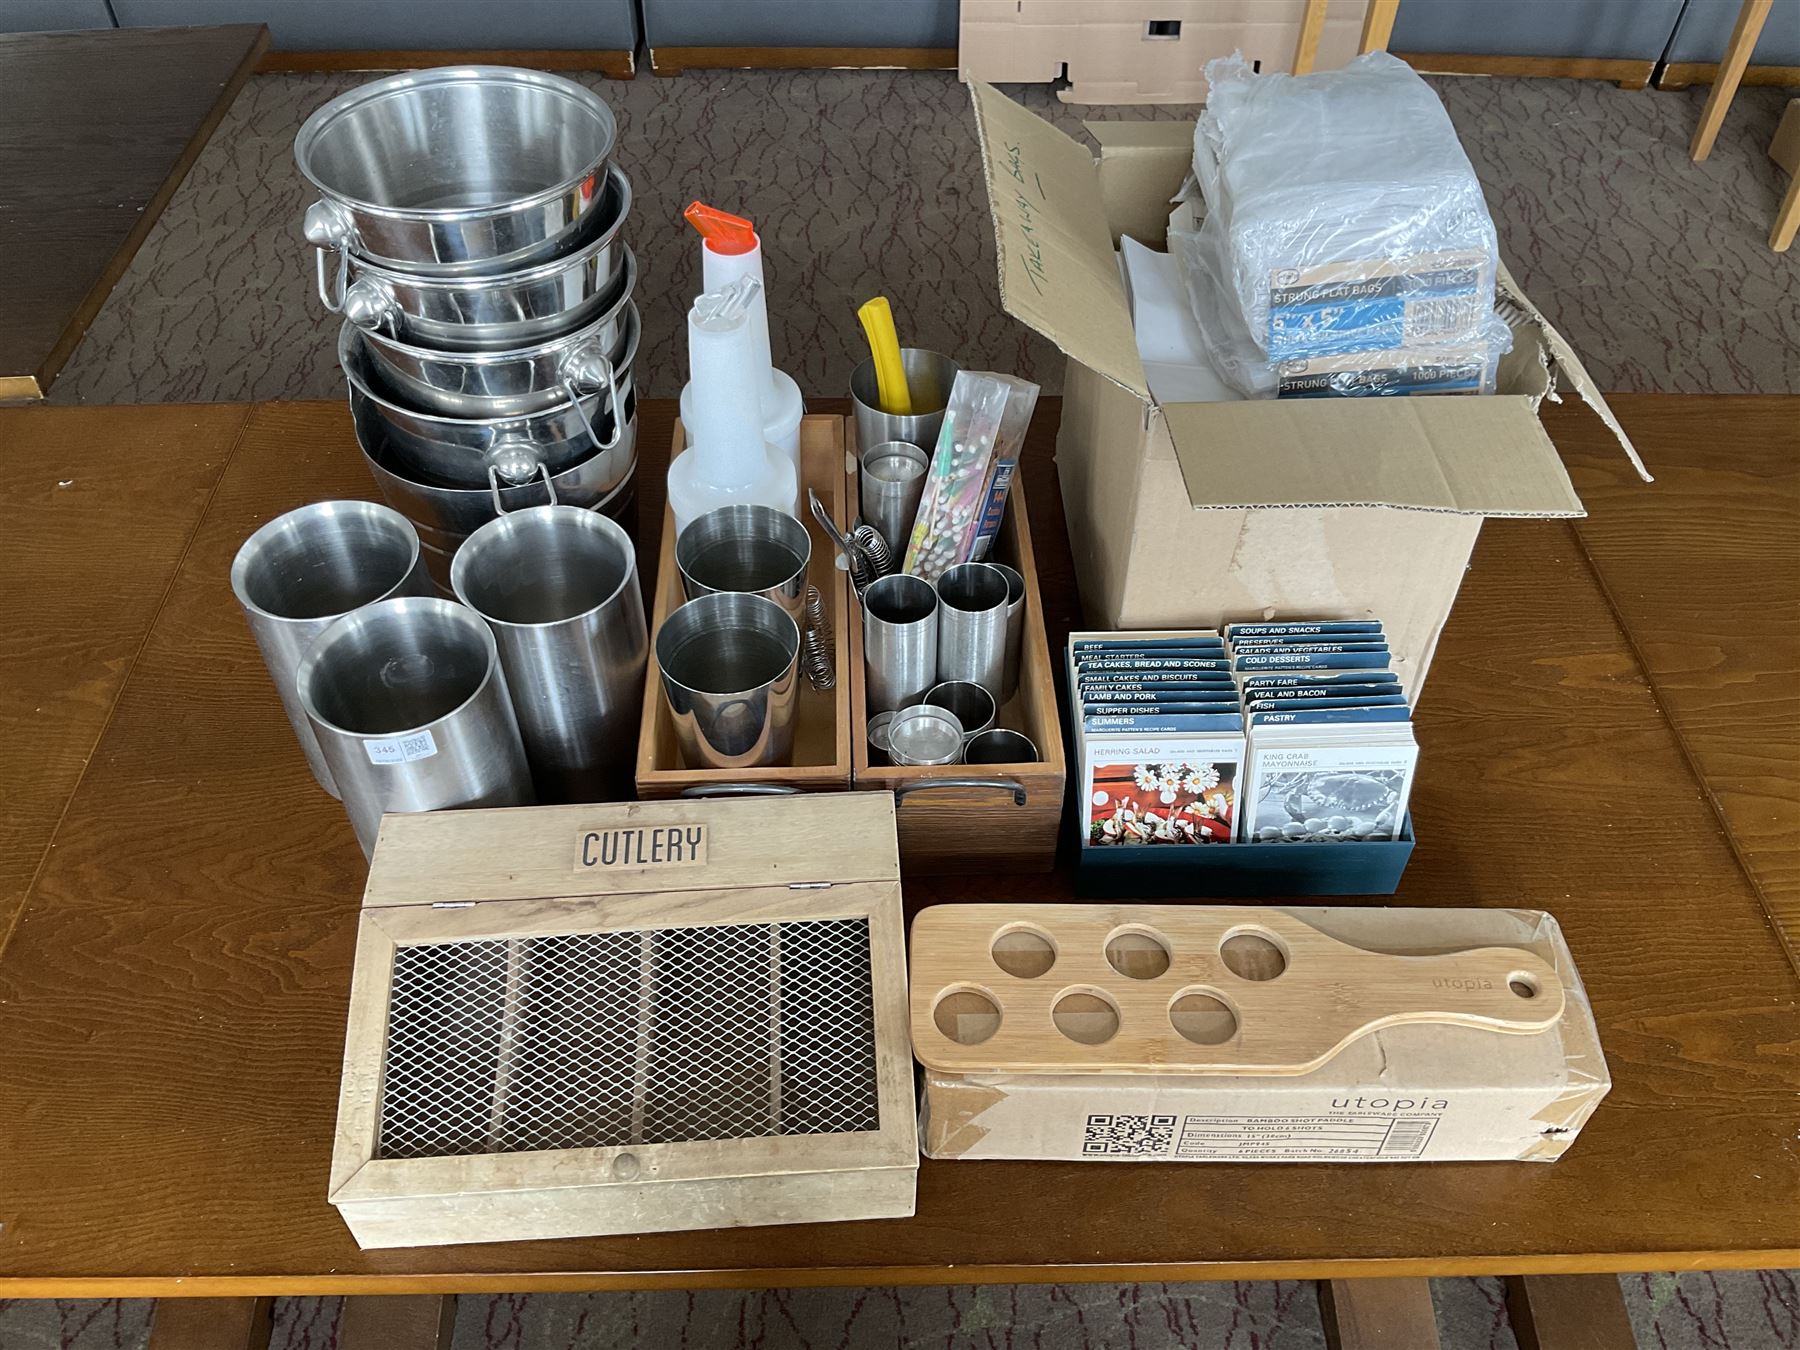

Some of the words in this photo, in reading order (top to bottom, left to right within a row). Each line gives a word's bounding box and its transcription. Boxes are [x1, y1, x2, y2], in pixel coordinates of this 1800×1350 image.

[1274, 289, 1319, 304] STRUNG
[1352, 283, 1382, 295] BAGS
[1358, 373, 1388, 384] BAGS
[1412, 369, 1437, 381] 1000
[1283, 378, 1328, 391] STRUNG
[374, 746, 396, 754] 345
[1262, 760, 1318, 768] MAYONNAISE
[582, 826, 702, 866] CUTLERY
[1432, 977, 1493, 992] utopia
[1332, 1096, 1448, 1112] utopia
